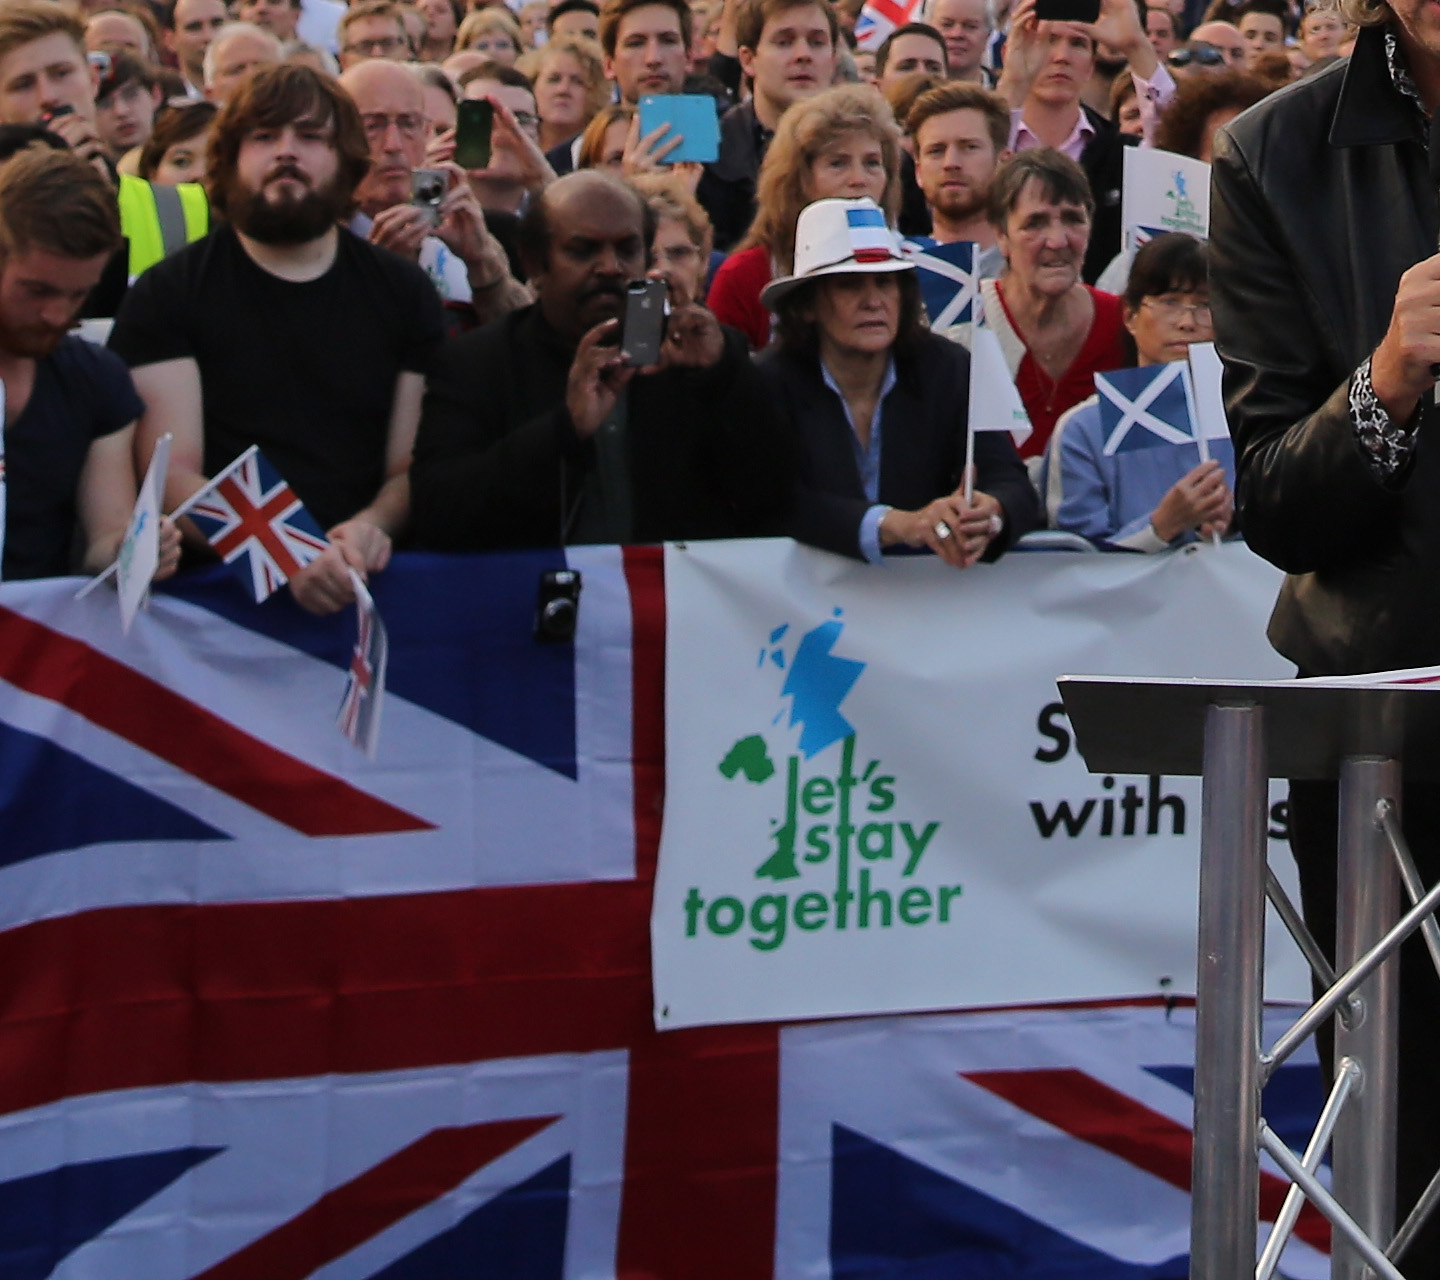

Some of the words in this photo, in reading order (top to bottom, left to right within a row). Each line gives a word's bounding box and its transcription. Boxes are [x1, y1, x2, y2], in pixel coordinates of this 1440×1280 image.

[787, 743, 896, 814] let's
[1029, 774, 1187, 839] with
[804, 819, 942, 878] stay
[683, 868, 963, 952] together
